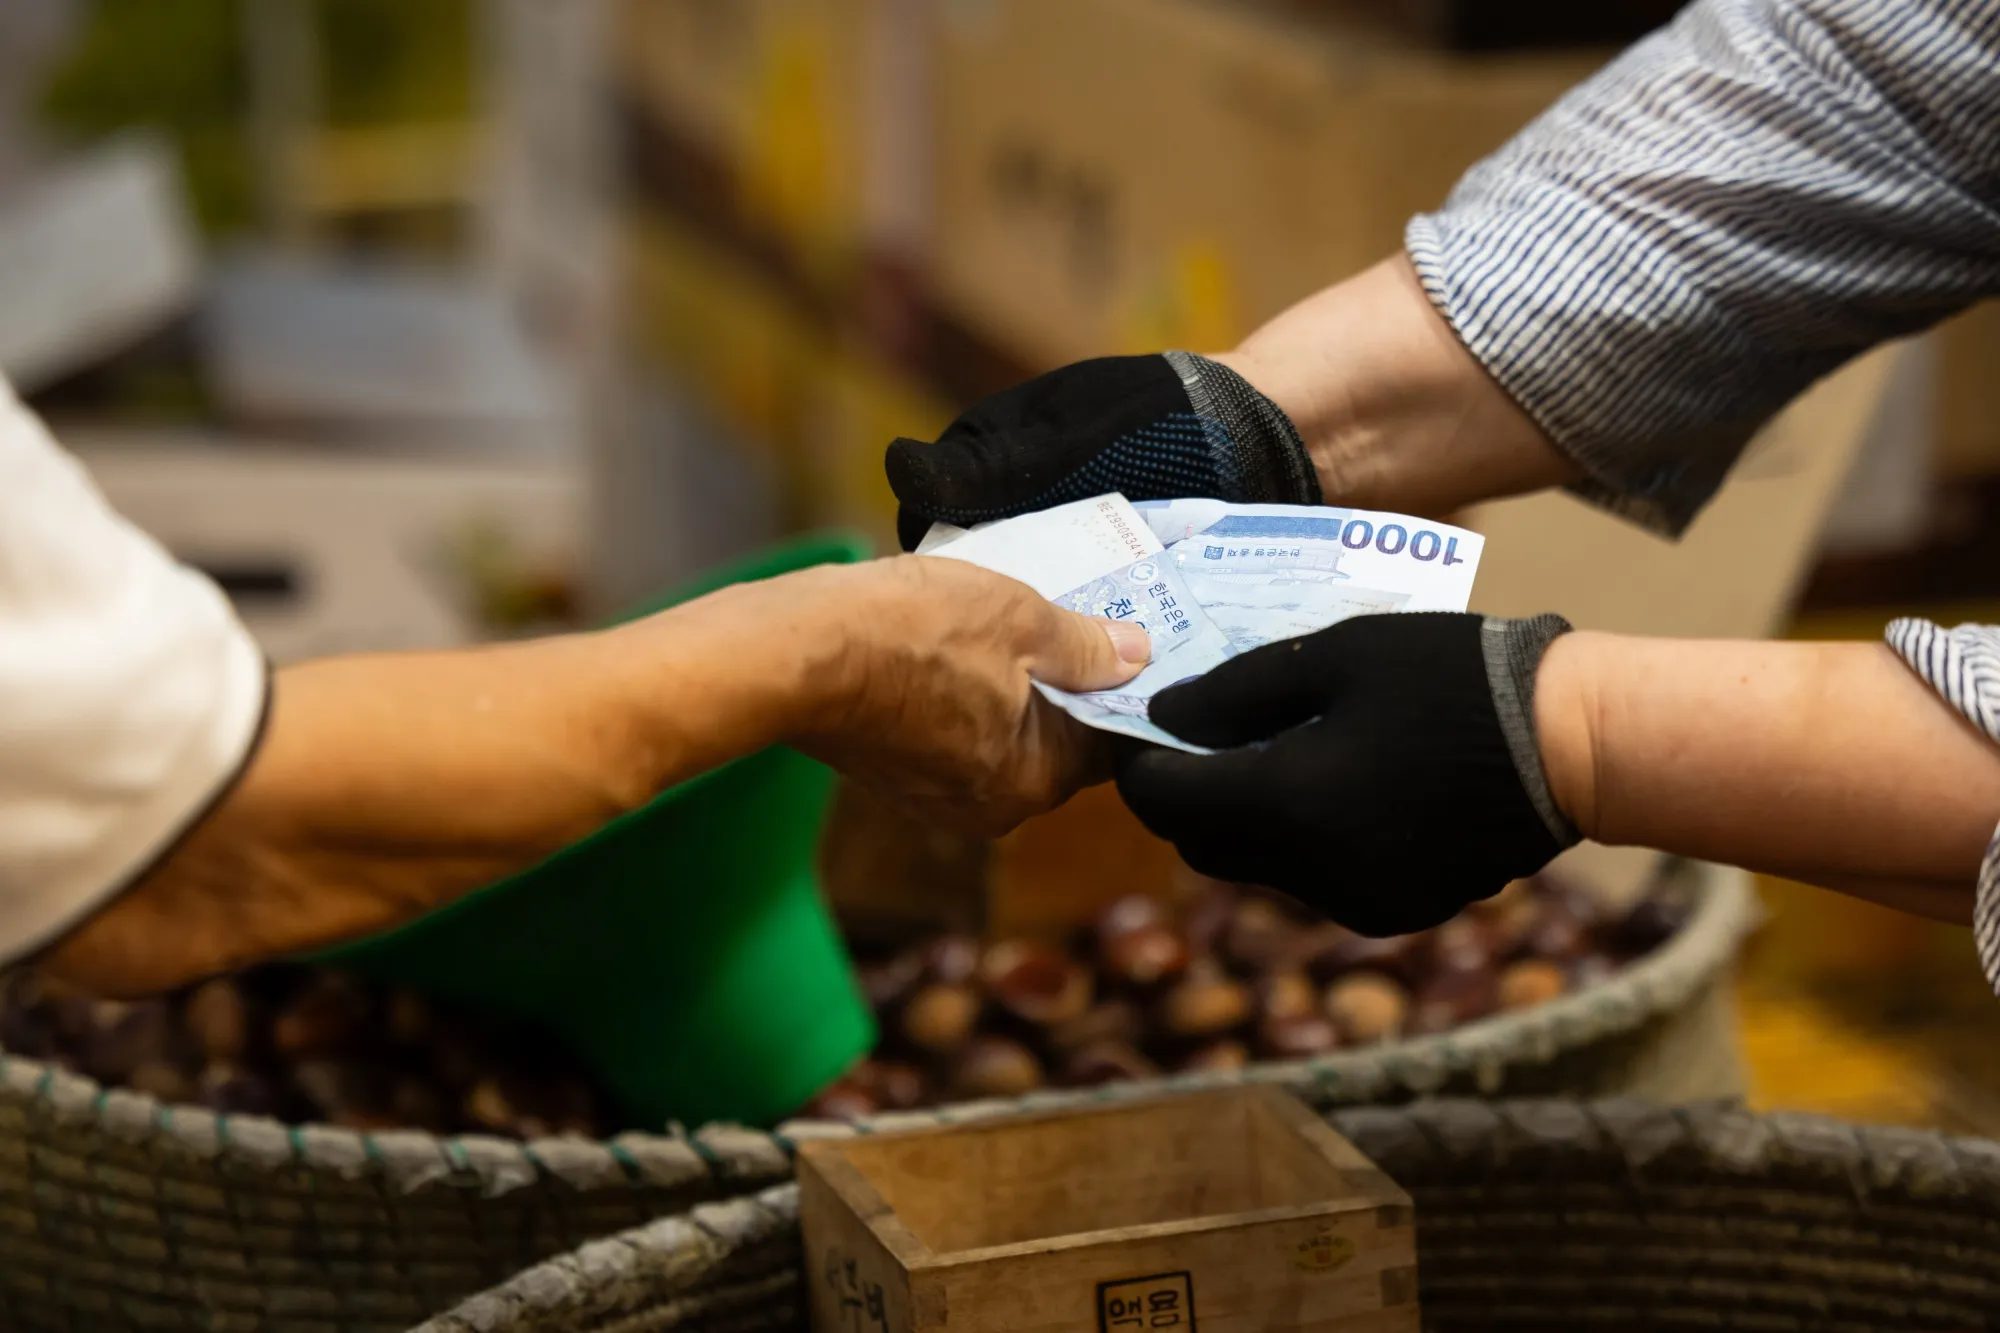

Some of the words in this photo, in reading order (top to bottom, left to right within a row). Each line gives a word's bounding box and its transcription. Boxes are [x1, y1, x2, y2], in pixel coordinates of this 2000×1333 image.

[1254, 548, 1301, 558] 한국은행
[1341, 519, 1464, 567] 1000
[1148, 582, 1193, 634] 한국은행
